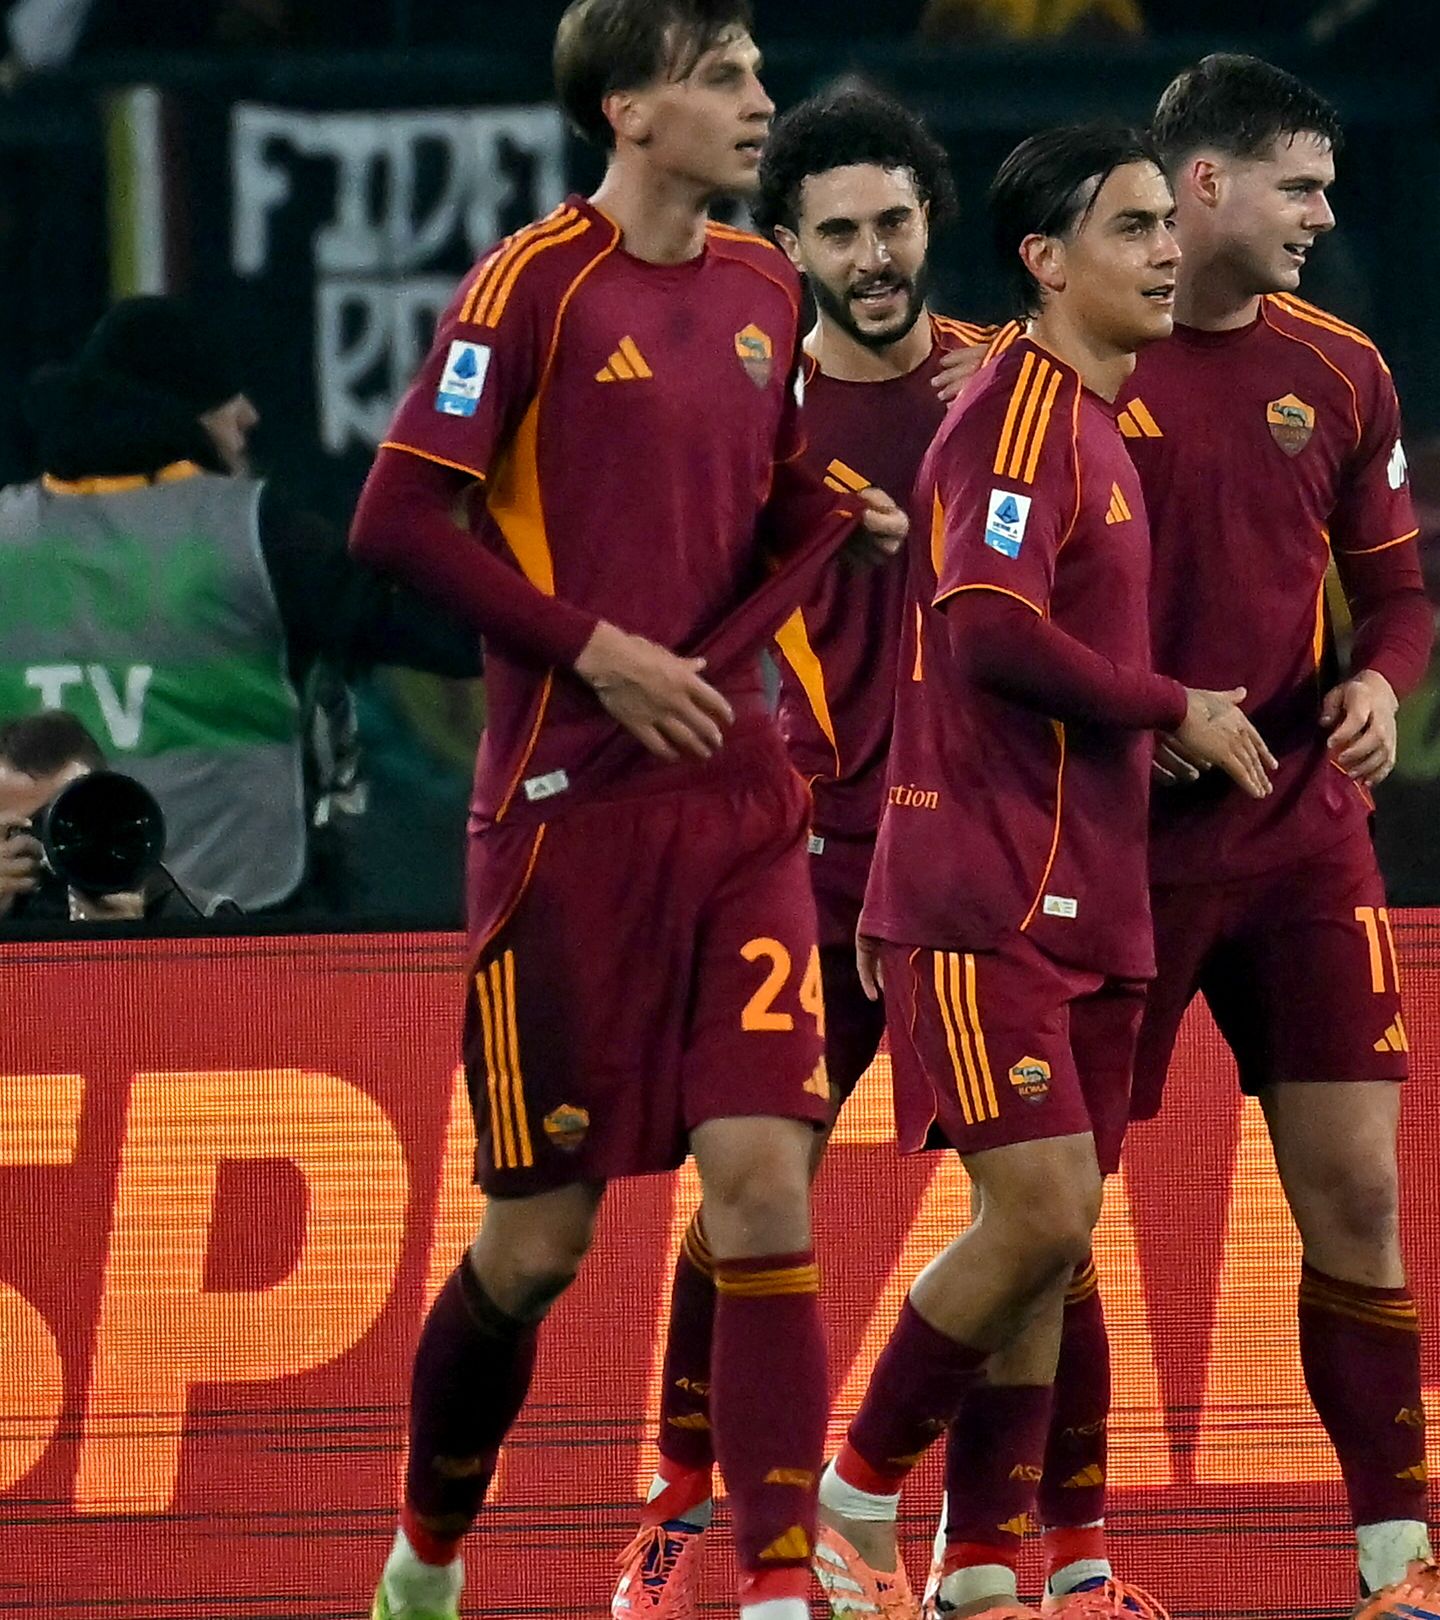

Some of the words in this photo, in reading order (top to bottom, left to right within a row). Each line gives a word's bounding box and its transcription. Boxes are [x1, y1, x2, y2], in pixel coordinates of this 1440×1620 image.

[26, 665, 152, 749] TV
[740, 937, 825, 1037] 24
[1355, 906, 1400, 993] 11
